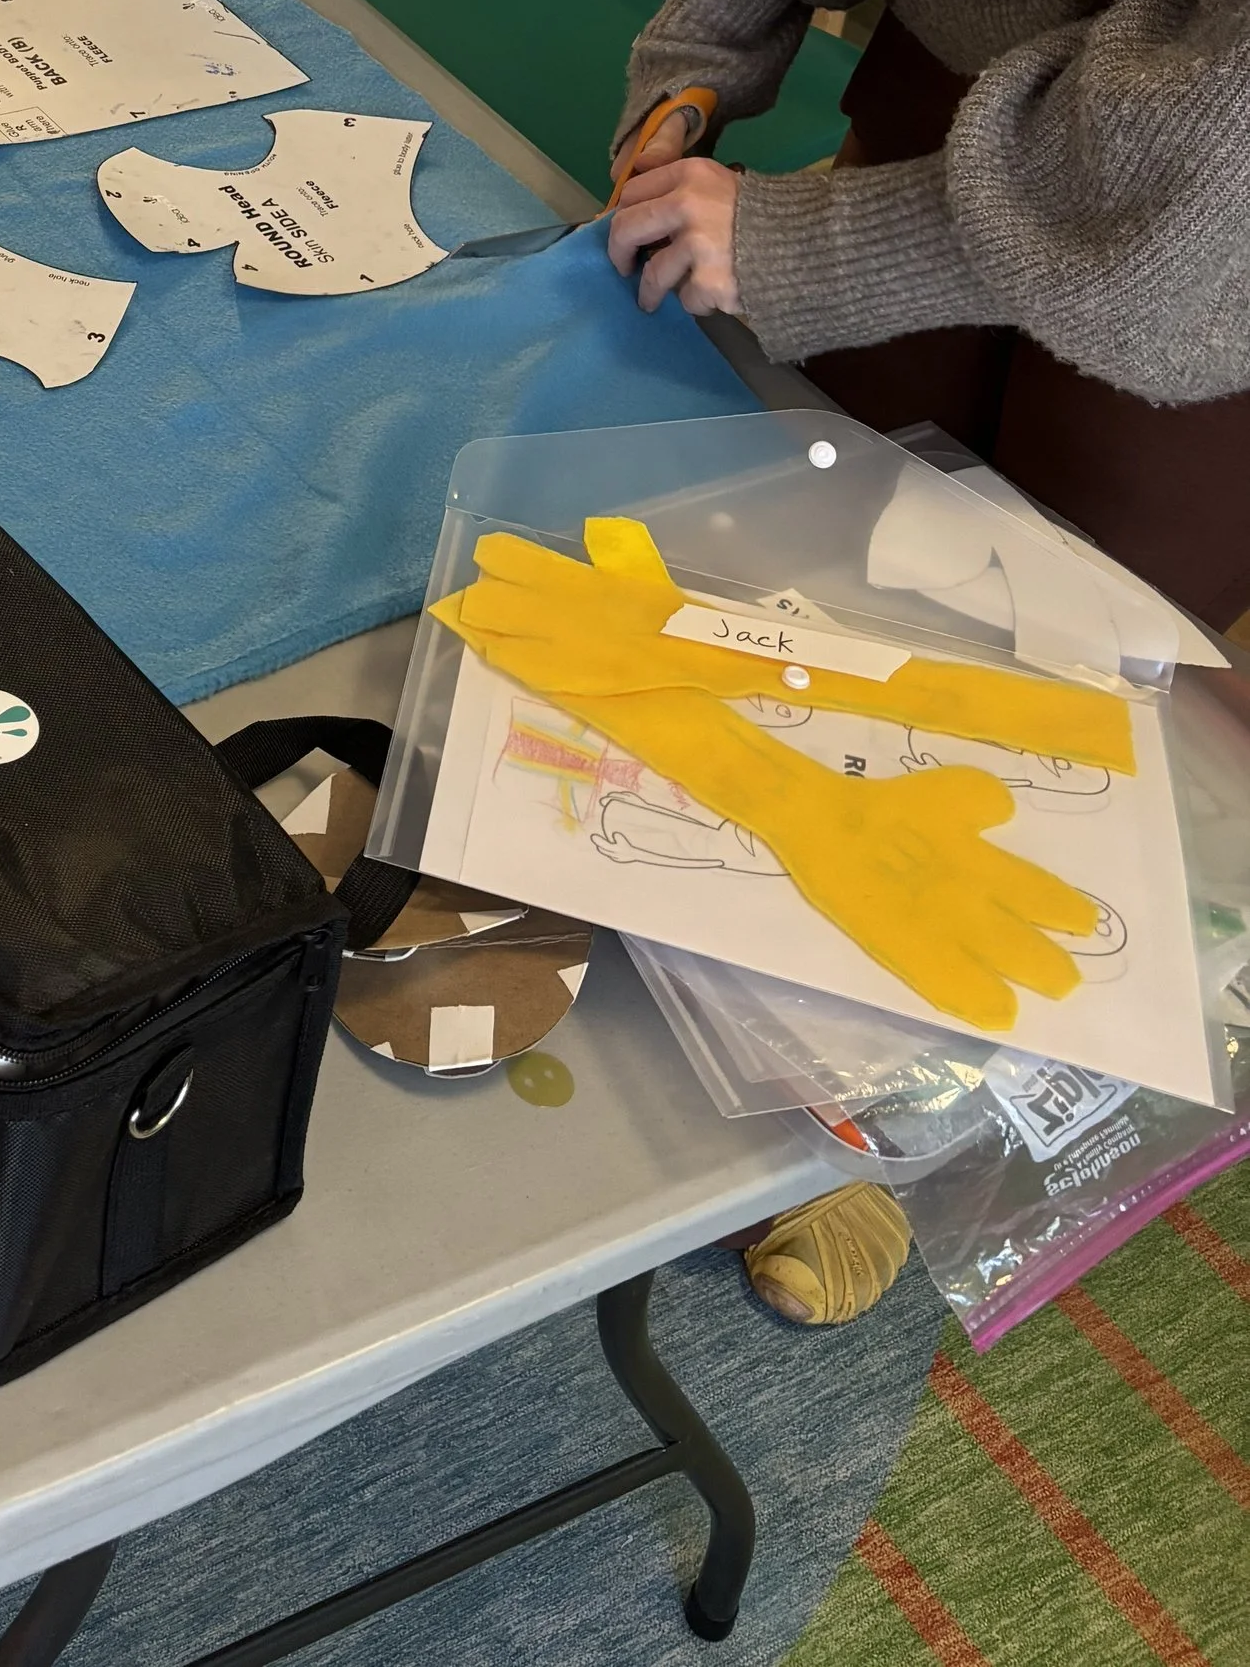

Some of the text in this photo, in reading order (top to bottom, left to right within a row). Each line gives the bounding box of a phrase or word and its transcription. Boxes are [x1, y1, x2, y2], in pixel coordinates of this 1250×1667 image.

[77, 35, 113, 64] FLEECE
[8, 36, 68, 86] BACK (B)
[78, 49, 99, 68] Trace
[16, 64, 48, 91] Puppet
[1, 122, 20, 138] Glue
[15, 124, 28, 132] R
[25, 118, 43, 132] arm
[343, 117, 357, 128] 3
[399, 144, 411, 158] body
[104, 189, 123, 199] 2
[305, 180, 340, 211] Fleece
[311, 200, 329, 218] Trace
[218, 185, 313, 269] ROUND Head
[261, 197, 335, 264] Skin SIDE A
[403, 222, 425, 249] neck hole
[187, 238, 201, 248] 4
[48, 273, 91, 287] neck hole
[359, 273, 375, 283] 1
[86, 332, 106, 343] 3
[713, 619, 794, 654] Jack
